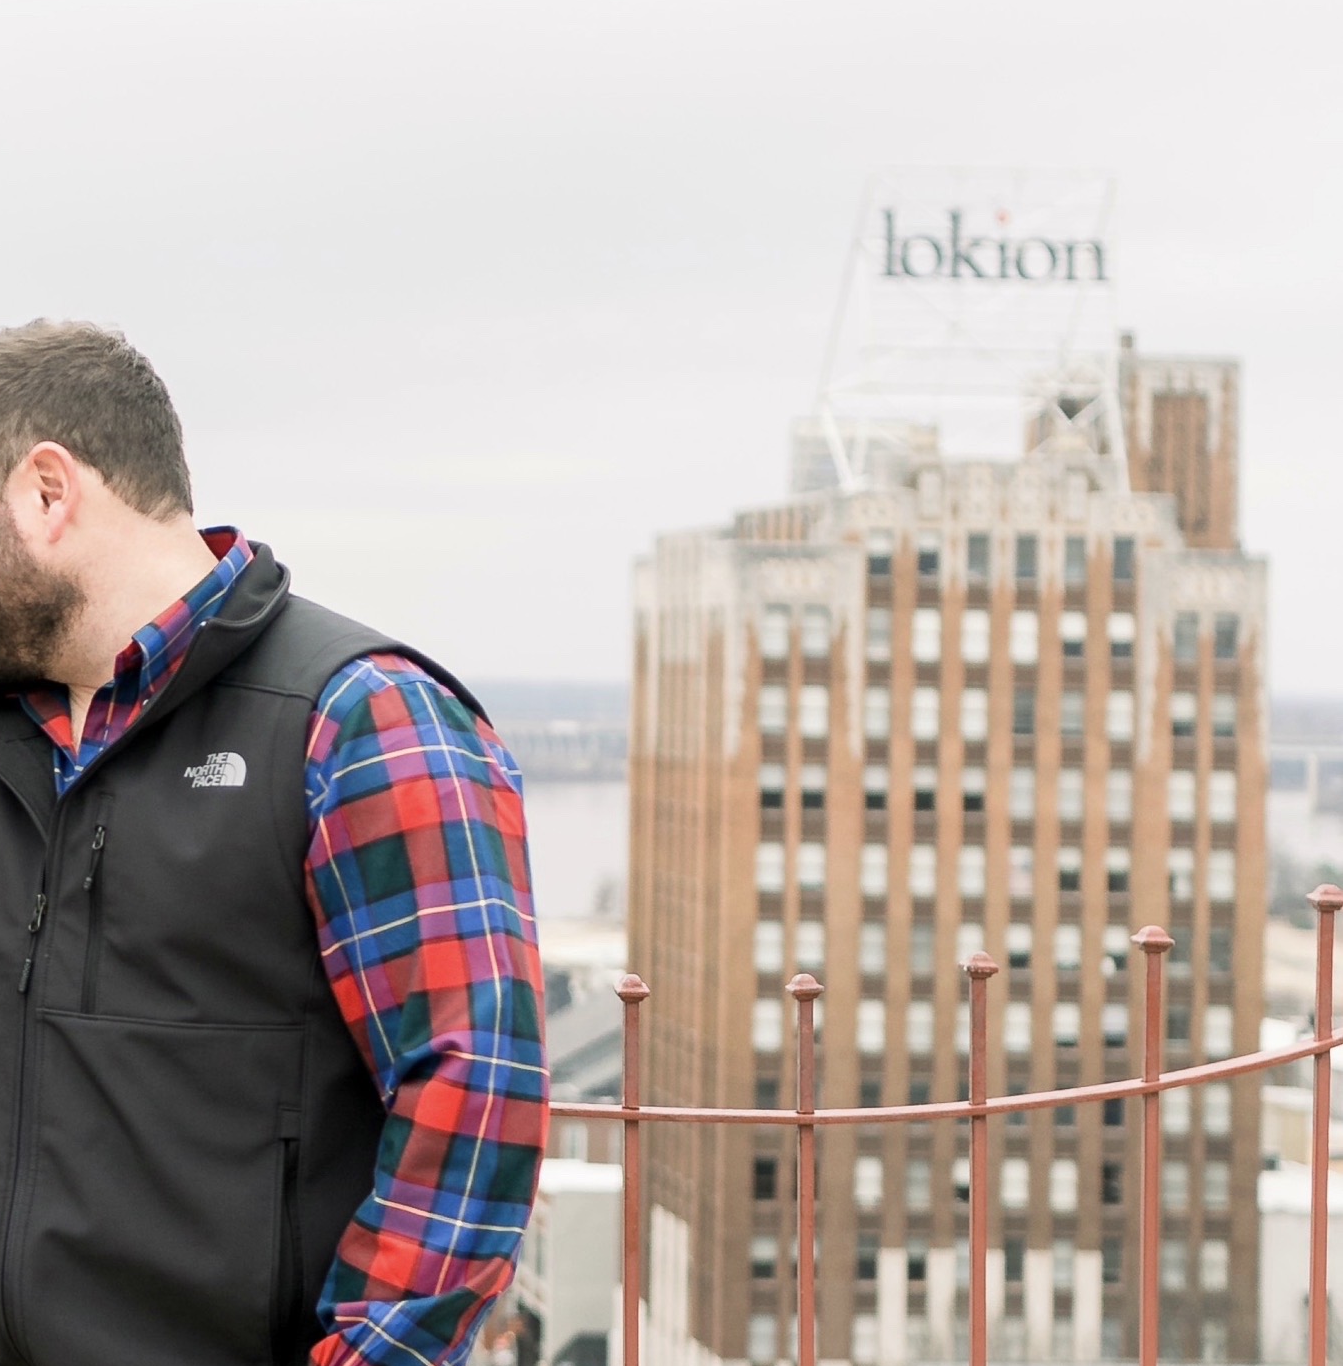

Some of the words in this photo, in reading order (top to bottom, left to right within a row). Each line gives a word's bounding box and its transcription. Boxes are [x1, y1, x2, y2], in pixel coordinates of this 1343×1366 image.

[880, 206, 1110, 281] lokion
[206, 752, 228, 764] THE
[183, 763, 224, 778] NORTH
[191, 775, 222, 788] FACE
